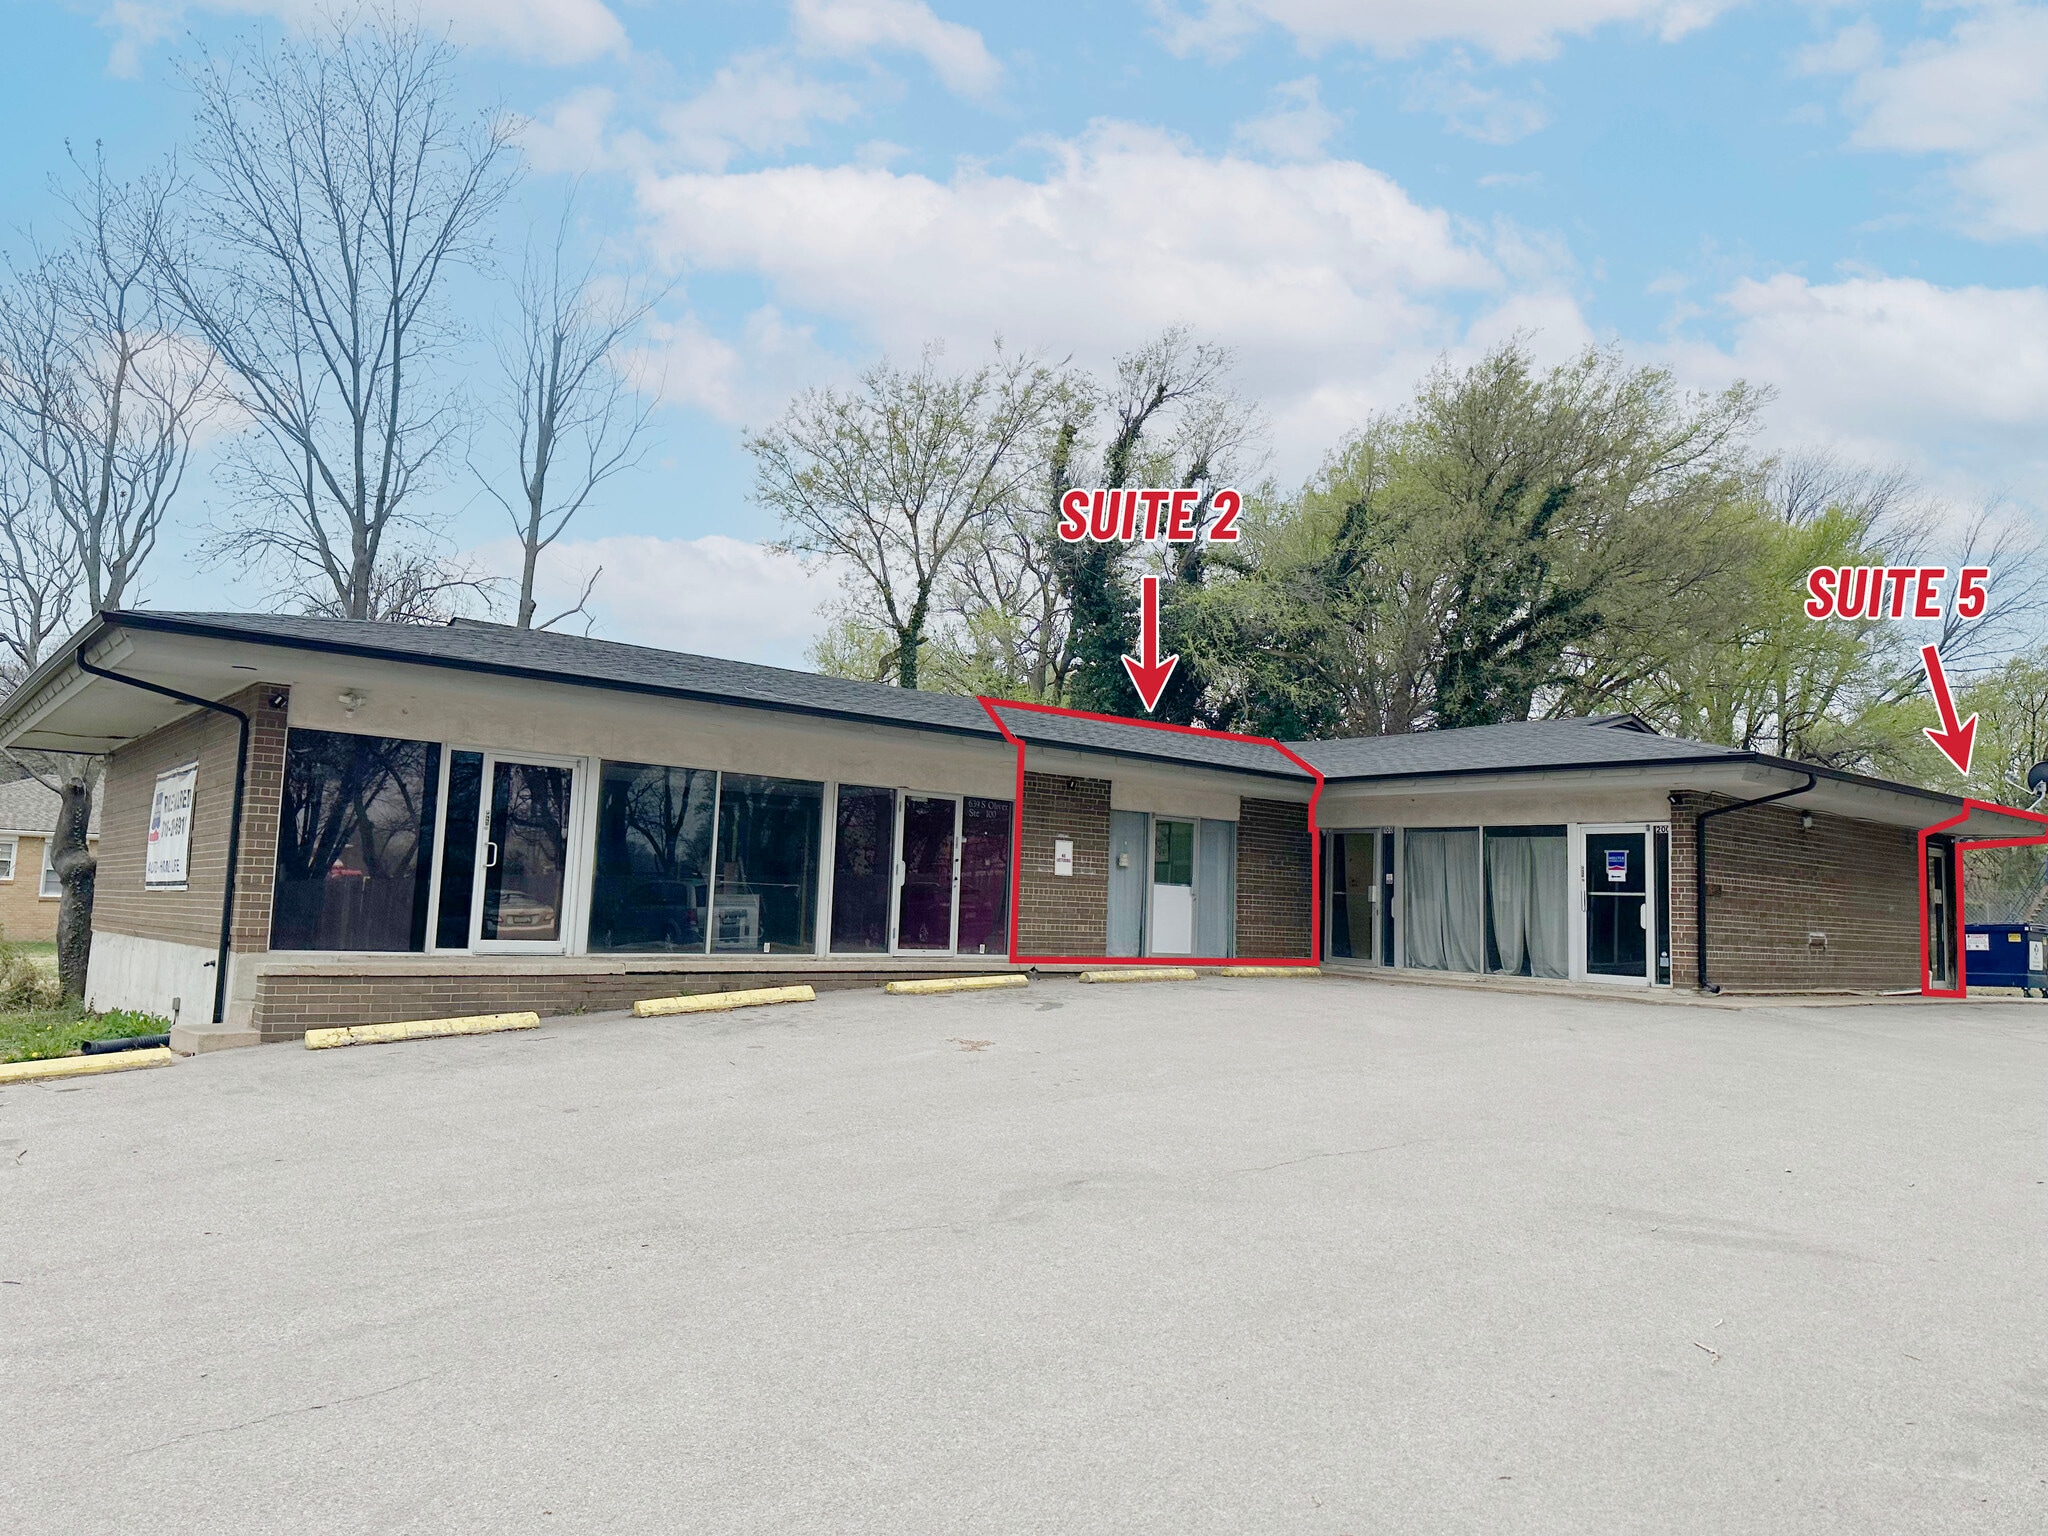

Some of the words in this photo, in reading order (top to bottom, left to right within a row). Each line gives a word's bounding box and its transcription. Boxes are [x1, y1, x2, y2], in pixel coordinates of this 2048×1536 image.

[981, 801, 986, 809] S
[968, 808, 980, 818] Ste
[986, 810, 996, 818] 100
